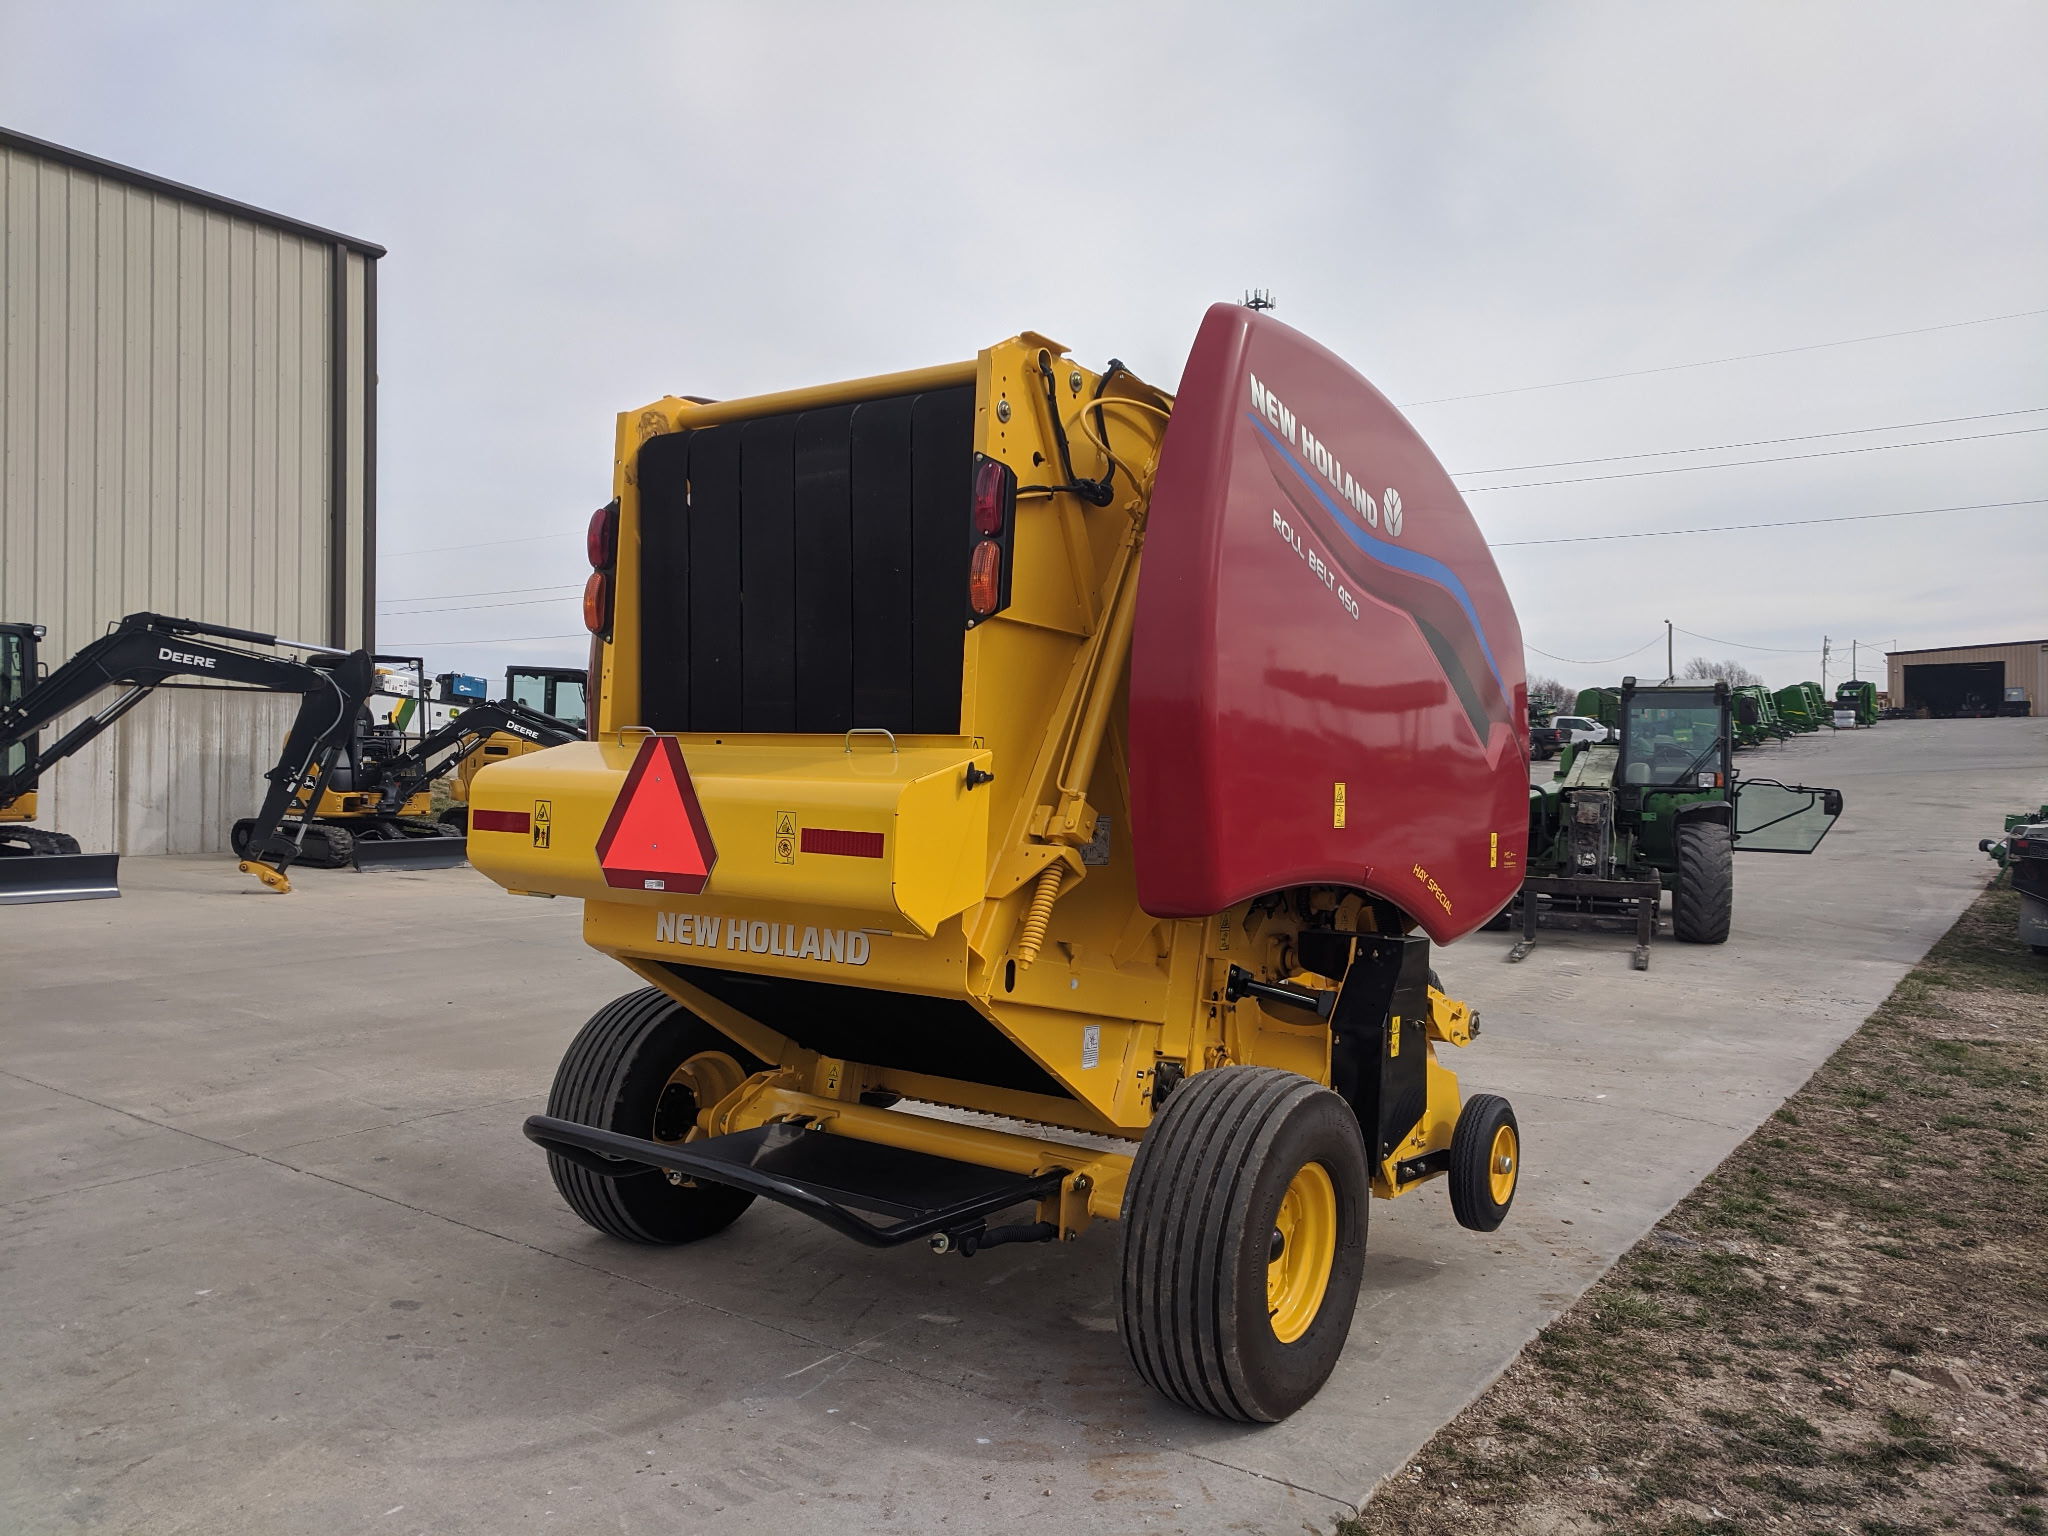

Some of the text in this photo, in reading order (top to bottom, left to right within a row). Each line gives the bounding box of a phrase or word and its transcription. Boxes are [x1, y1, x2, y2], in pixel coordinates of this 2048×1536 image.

[1250, 372, 1378, 529] NEW HOLLAND
[1273, 508, 1359, 620] ROLL BELT 450
[159, 648, 217, 669] DEERE
[506, 720, 539, 739] DEERE
[1412, 863, 1453, 916] HAY SPECIAL
[656, 911, 870, 966] NEW HOLLAND
